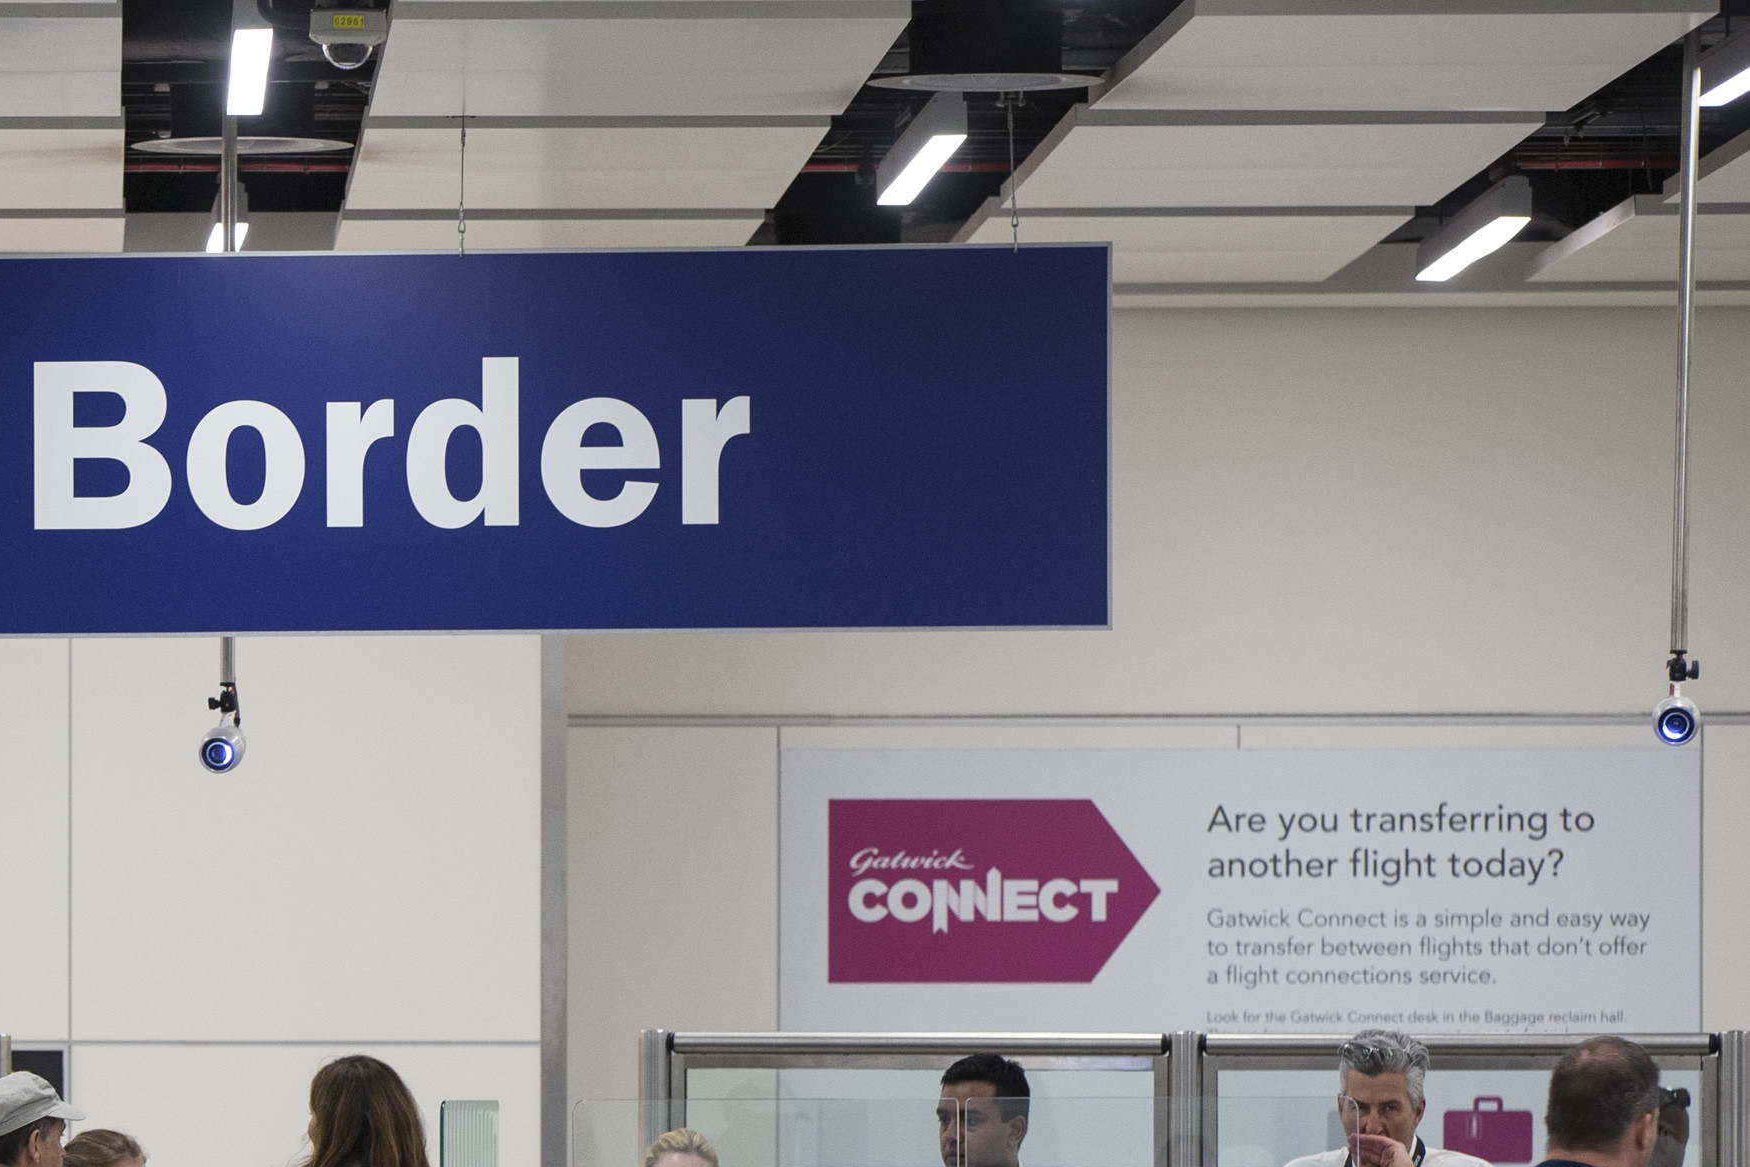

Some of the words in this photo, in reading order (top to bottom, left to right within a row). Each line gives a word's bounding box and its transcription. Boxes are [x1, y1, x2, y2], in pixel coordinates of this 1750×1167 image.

[34, 357, 750, 530] Border
[1208, 805, 1266, 832] Are
[1279, 814, 1337, 841] you
[1351, 802, 1547, 840] transferring
[1560, 808, 1594, 832] to
[850, 848, 974, 877] Gatwick
[1209, 849, 1338, 877] another
[1350, 848, 1435, 886] flight
[1448, 848, 1564, 885] today?
[848, 866, 1118, 934] CONNECT
[1207, 909, 1289, 927] Gatwick
[1298, 909, 1385, 927] Connect
[1394, 908, 1409, 928] is
[1416, 915, 1426, 927] a
[1435, 908, 1502, 933] simple
[1510, 908, 1549, 927] and
[1557, 914, 1603, 933] easy
[1610, 913, 1650, 933] way
[1208, 941, 1228, 955] to
[1236, 937, 1313, 955] transfer
[1322, 938, 1411, 955] between
[1420, 936, 1482, 960] flights
[1490, 936, 1529, 955] that
[1537, 936, 1591, 955] don't
[1599, 935, 1647, 955] offer
[1207, 971, 1218, 984] a
[1226, 965, 1277, 989] flight
[1286, 967, 1412, 984] connections
[1419, 966, 1496, 984] service.
[1207, 1010, 1238, 1023] Look
[1243, 1010, 1261, 1023] for
[1266, 1010, 1286, 1023] the
[1290, 1010, 1342, 1023] Gatwick
[1347, 1010, 1403, 1023] Connect
[1408, 1010, 1438, 1023] desk
[1442, 1010, 1454, 1023] in
[1459, 1010, 1481, 1023] the
[1485, 1010, 1544, 1026] Baggage
[1549, 1010, 1597, 1023] reclaim
[1601, 1010, 1627, 1023] hall.
